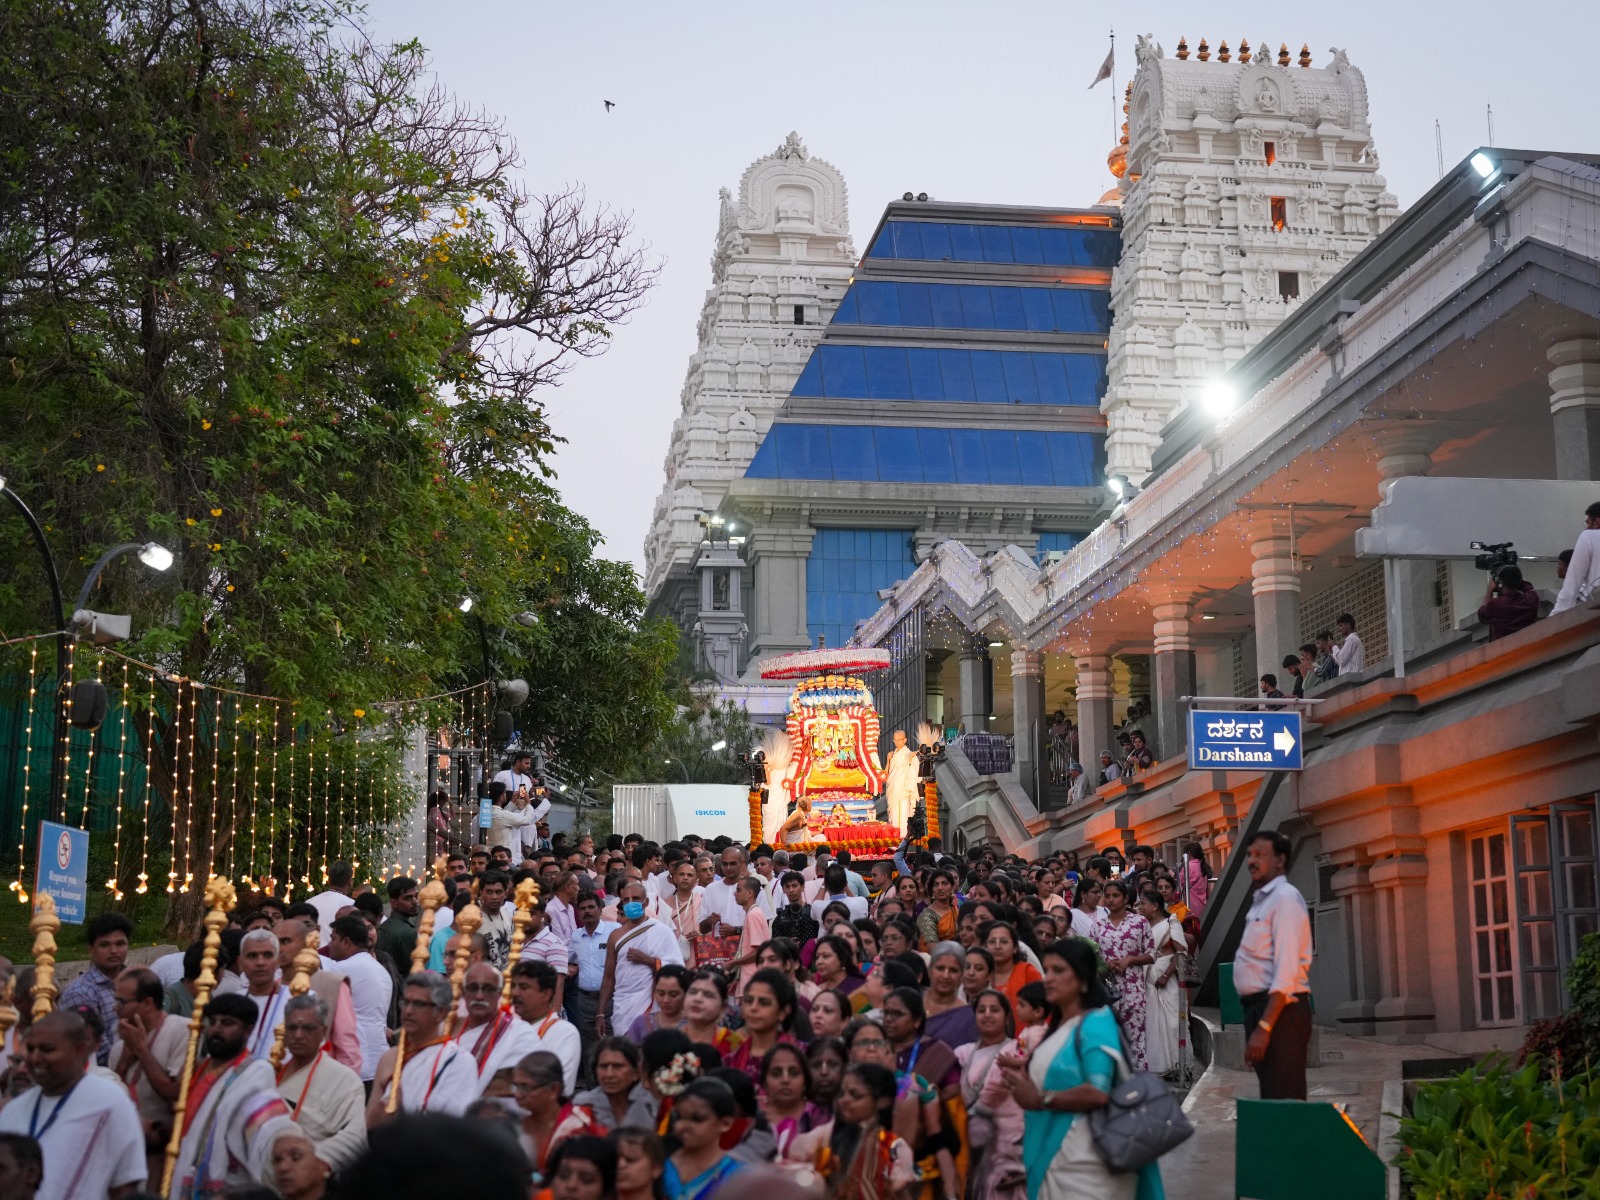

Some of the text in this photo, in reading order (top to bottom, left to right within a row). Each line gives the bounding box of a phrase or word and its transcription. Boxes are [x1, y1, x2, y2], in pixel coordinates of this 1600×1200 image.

[1207, 718, 1264, 739] ದರ್ಶನ
[1198, 746, 1273, 762] Darshana
[49, 870, 68, 885] Request
[60, 888, 81, 900] footwear
[61, 904, 78, 916] vehicle
